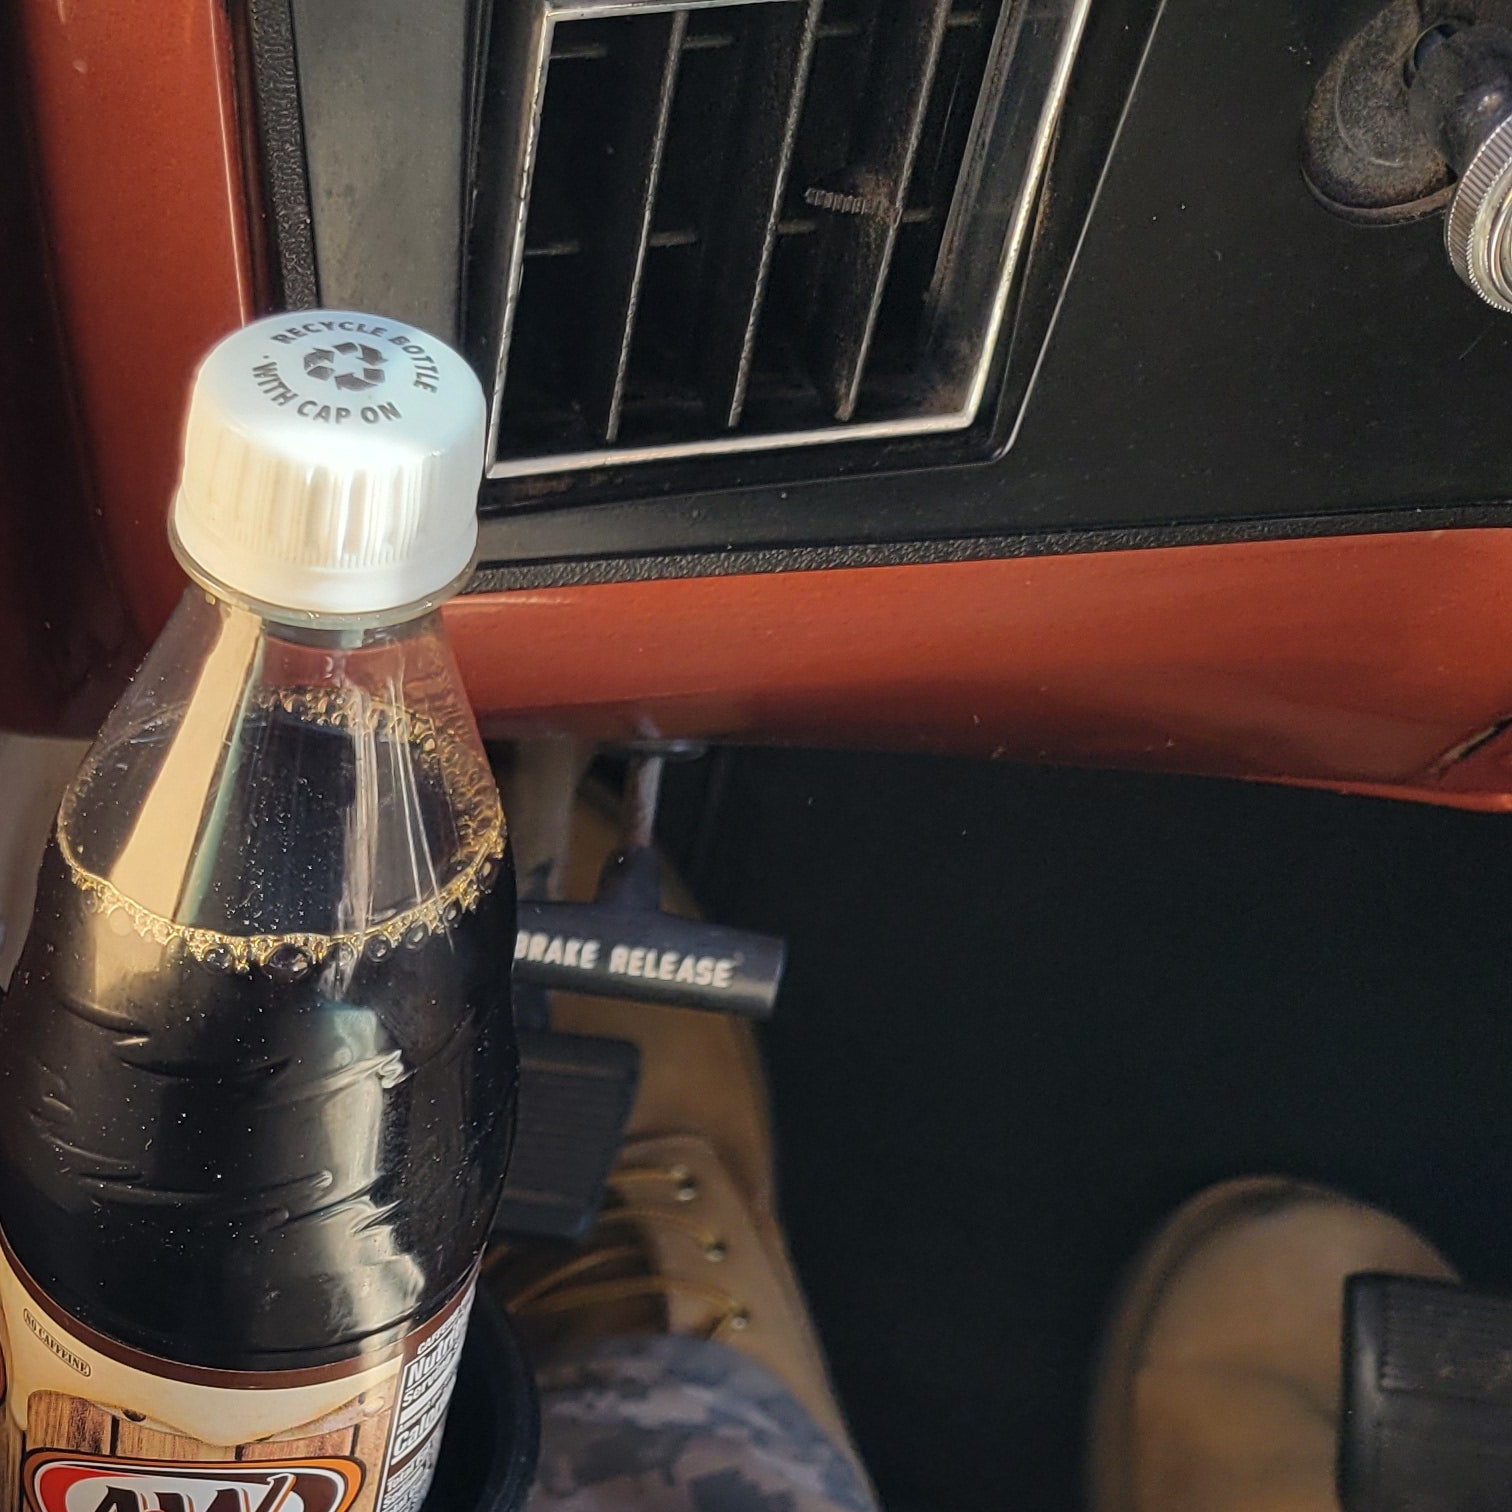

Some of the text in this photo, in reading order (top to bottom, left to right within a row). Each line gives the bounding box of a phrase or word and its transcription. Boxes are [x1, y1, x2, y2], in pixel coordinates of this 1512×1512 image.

[271, 321, 440, 394] RECYCLE BOTTLE
[252, 360, 402, 425] WITH CAP ON
[513, 929, 736, 989] BRAKE RELEASE
[38, 1328, 88, 1375] CAFFEINE
